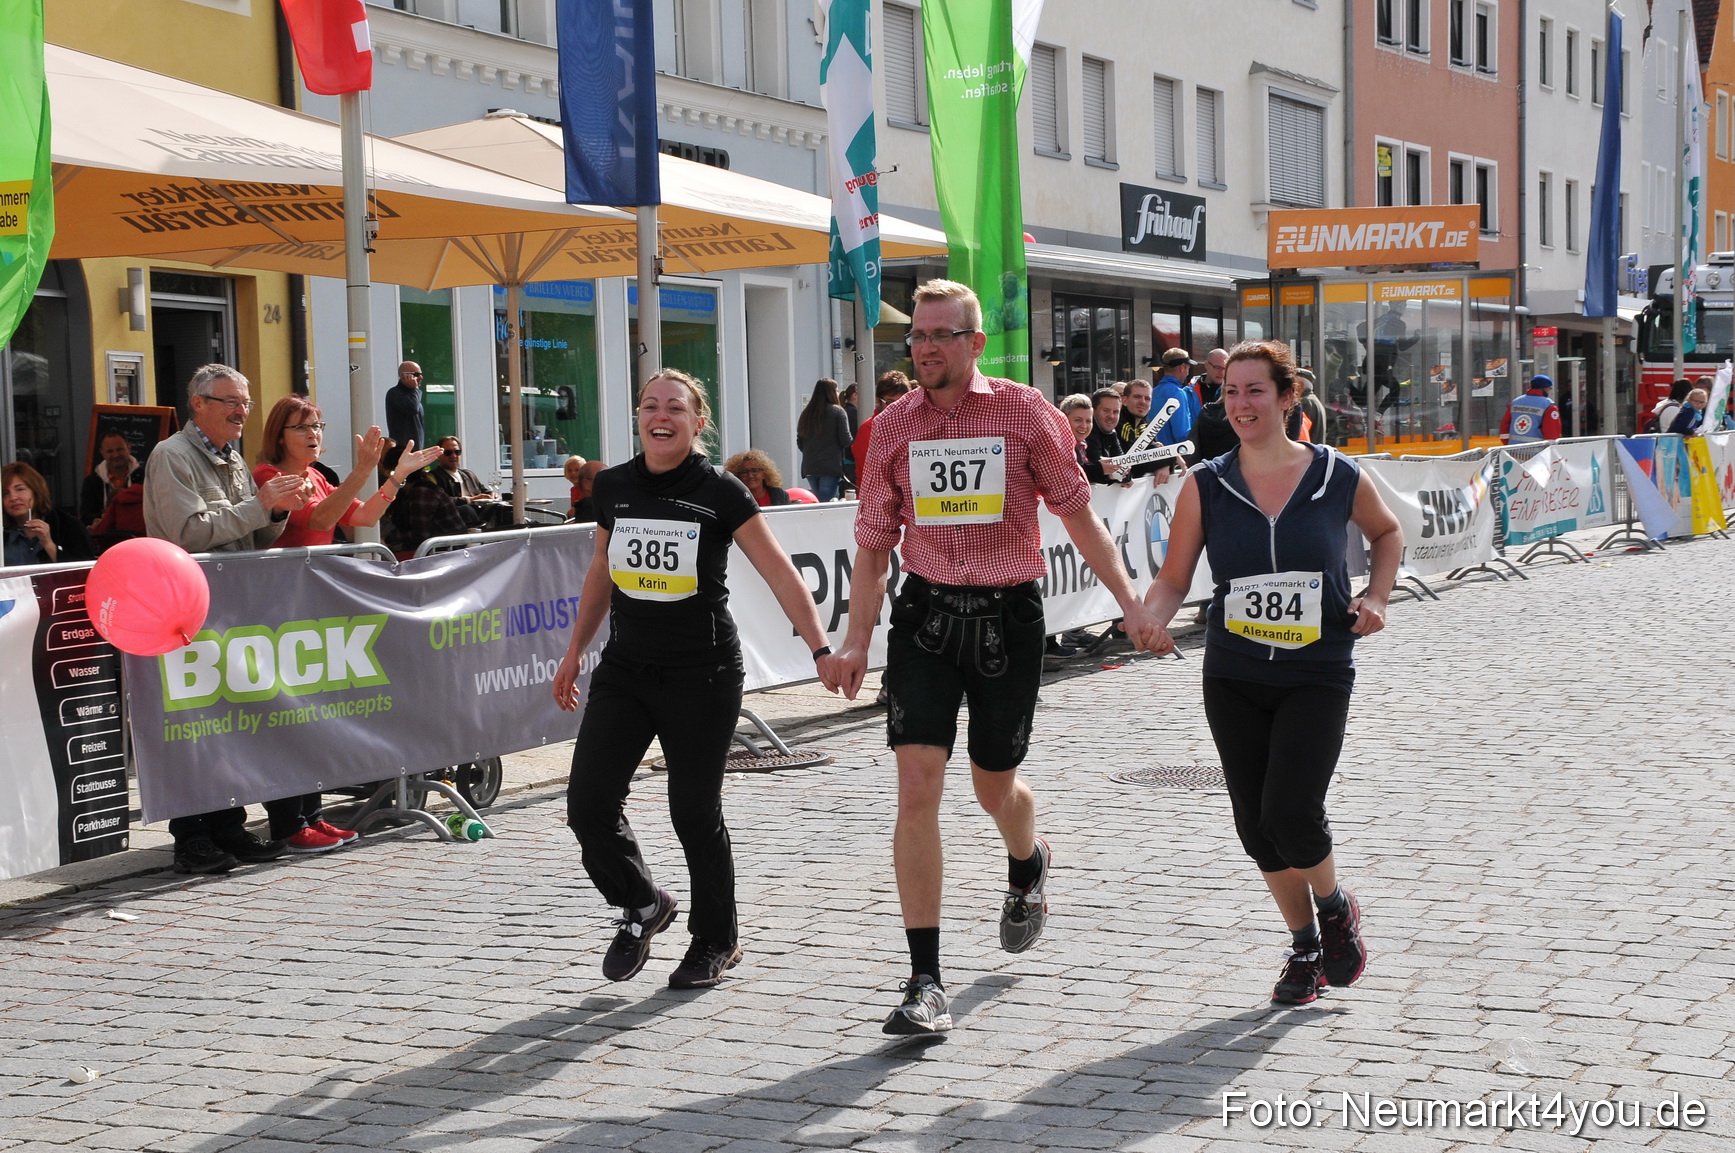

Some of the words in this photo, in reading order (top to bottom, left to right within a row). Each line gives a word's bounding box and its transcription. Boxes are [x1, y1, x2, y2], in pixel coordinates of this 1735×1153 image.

[1129, 193, 1206, 253] frühauf
[1275, 221, 1470, 254] RUNMARKT.DE
[562, 284, 590, 299] WEBER
[264, 303, 282, 325] 24
[552, 338, 568, 350] Linie
[912, 448, 942, 458] PARTL
[944, 447, 988, 456] Neumarkt
[929, 459, 986, 493] 367
[940, 499, 978, 513] Martin
[615, 526, 641, 534] PARTL
[643, 527, 683, 538] Neumarkt
[626, 538, 679, 572] 385
[638, 576, 667, 591] Karin
[1245, 591, 1304, 621] 384
[61, 628, 95, 641] Erdgas
[429, 608, 502, 650] OFFICE
[1242, 625, 1303, 642] Alexandra
[163, 624, 378, 700] BOCK
[69, 664, 101, 678] Wasser
[76, 703, 104, 718] Wärme
[164, 710, 233, 744] inspired
[238, 708, 263, 735] by
[268, 702, 319, 728] smart
[320, 692, 393, 719] concepts
[81, 739, 108, 755] Freizeit
[76, 777, 118, 795] Stadtbusse
[77, 816, 121, 834] Parkhäuser
